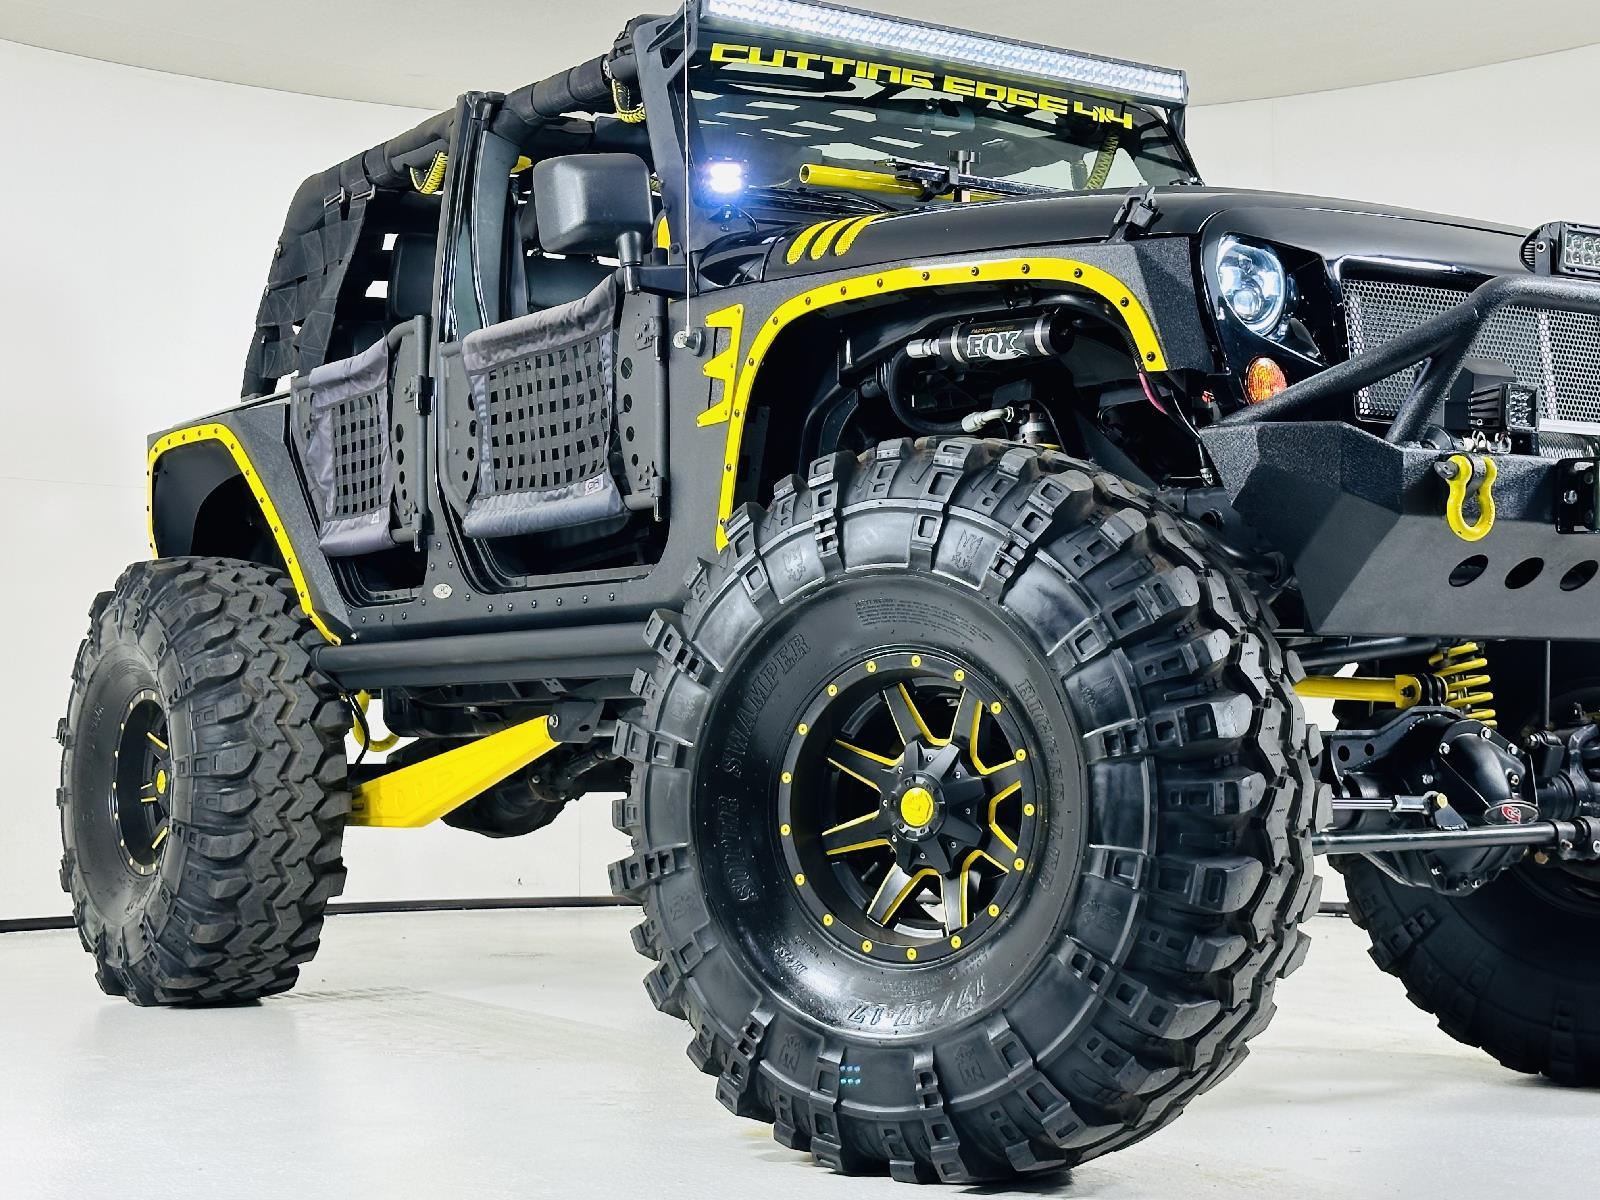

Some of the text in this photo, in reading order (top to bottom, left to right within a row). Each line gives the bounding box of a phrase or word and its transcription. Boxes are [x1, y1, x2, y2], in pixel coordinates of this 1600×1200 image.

[710, 43, 937, 88] CUTTING
[943, 74, 1068, 115] EDGE
[967, 330, 1023, 360] FOX
[721, 633, 811, 778] SWAMPER
